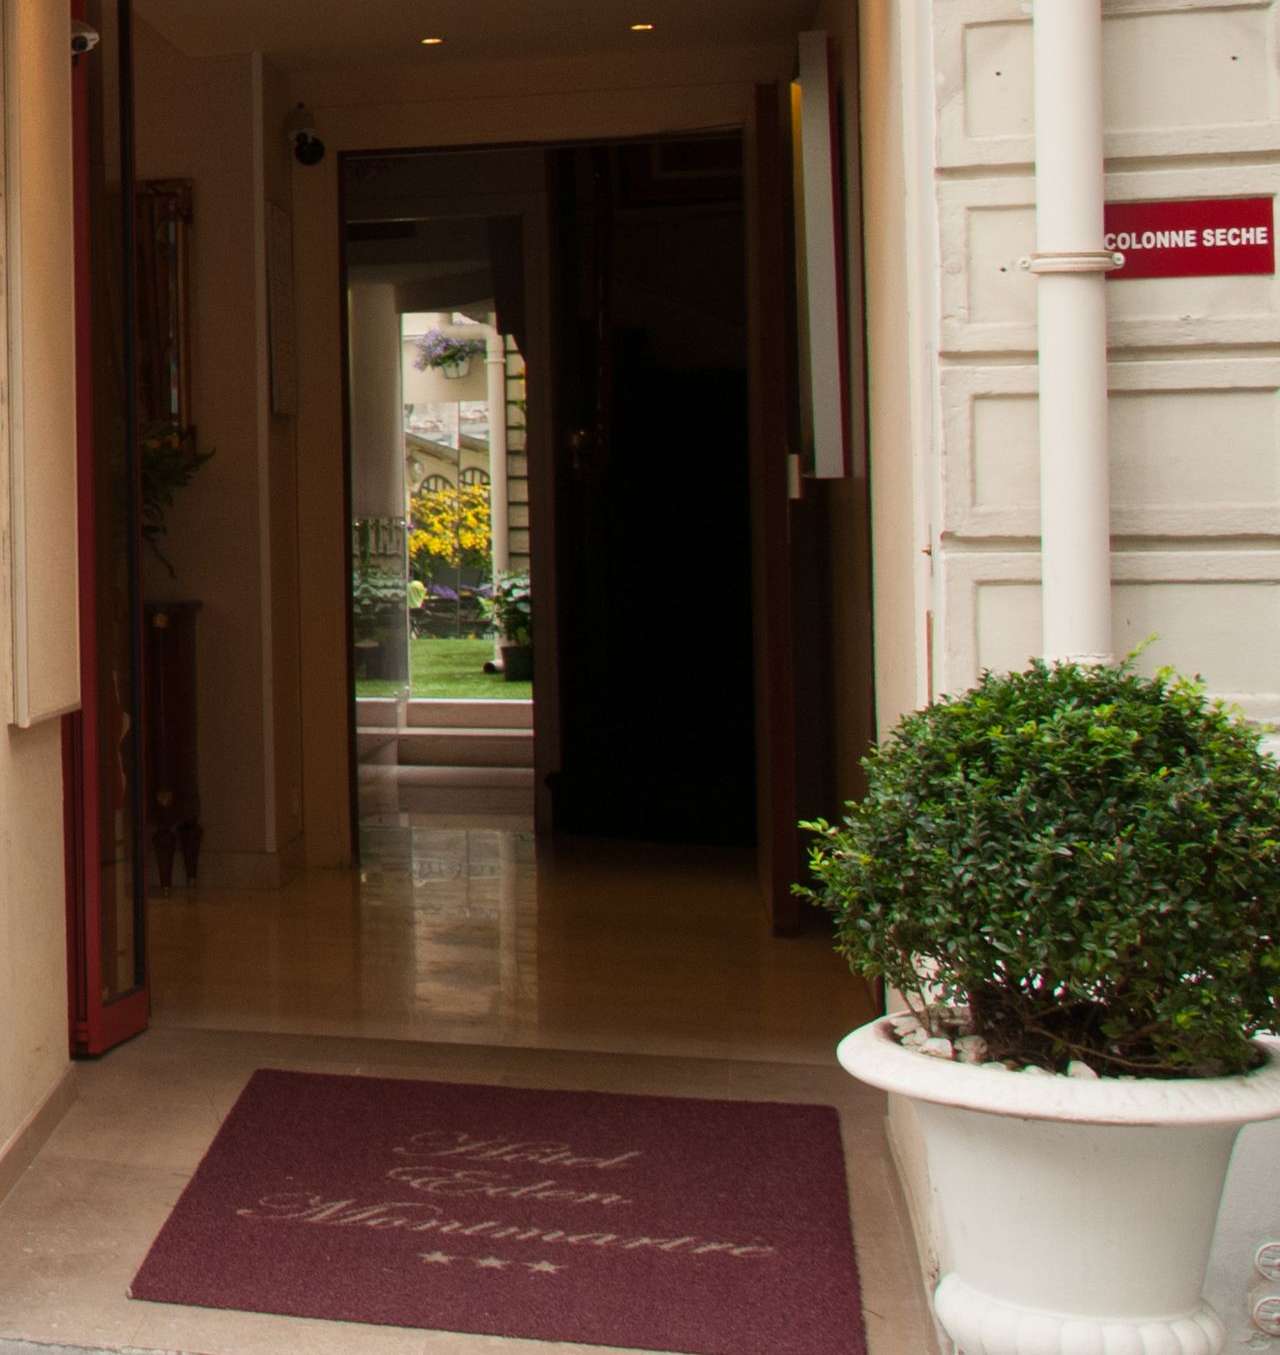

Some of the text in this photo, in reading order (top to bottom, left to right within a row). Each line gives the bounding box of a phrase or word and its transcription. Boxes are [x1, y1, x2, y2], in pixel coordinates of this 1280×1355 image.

[1104, 227, 1268, 250] COLONNE SECHE
[386, 1166, 633, 1204] Eden
[237, 1192, 774, 1257] Montmartre
